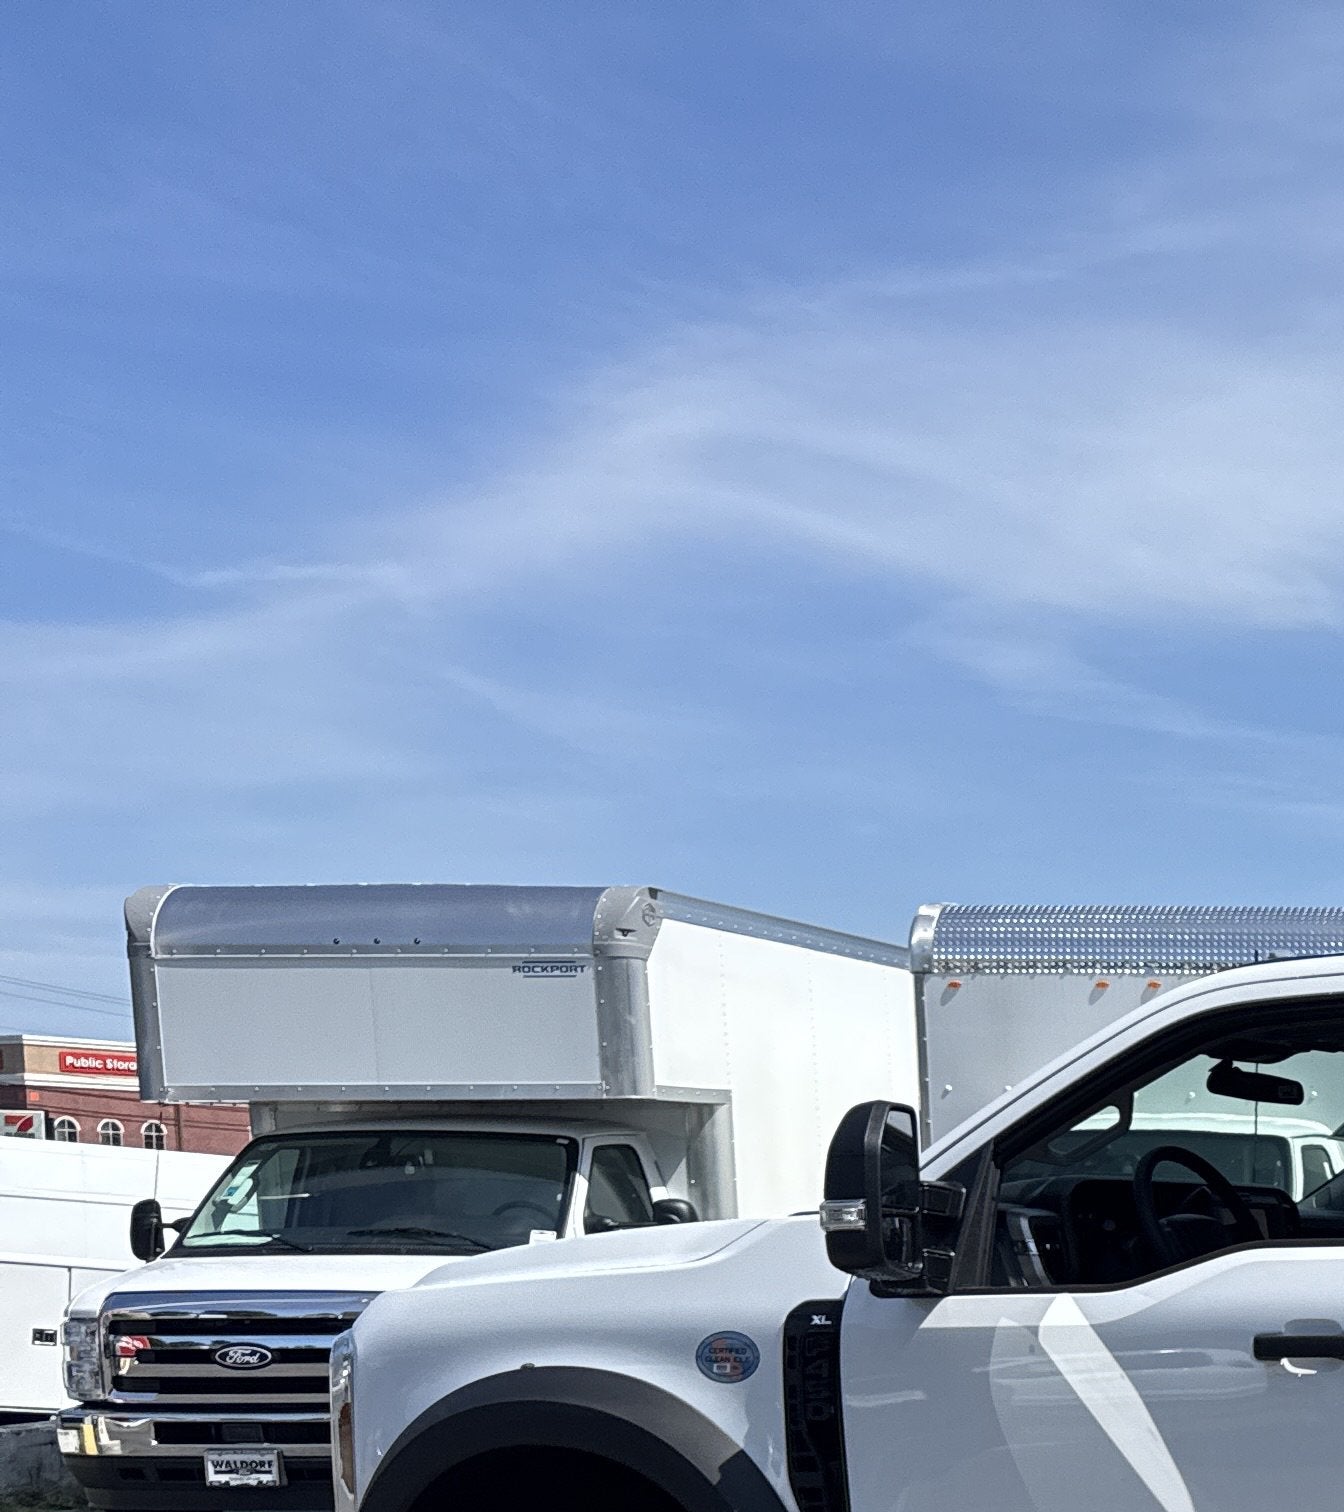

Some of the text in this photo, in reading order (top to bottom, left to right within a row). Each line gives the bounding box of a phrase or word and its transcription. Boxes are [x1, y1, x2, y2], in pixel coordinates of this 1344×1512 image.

[511, 964, 586, 974] ROCKPORT
[65, 1055, 104, 1069] Public
[810, 1314, 832, 1325] XL
[226, 1349, 260, 1364] Ford
[211, 1459, 274, 1470] WALDORF
